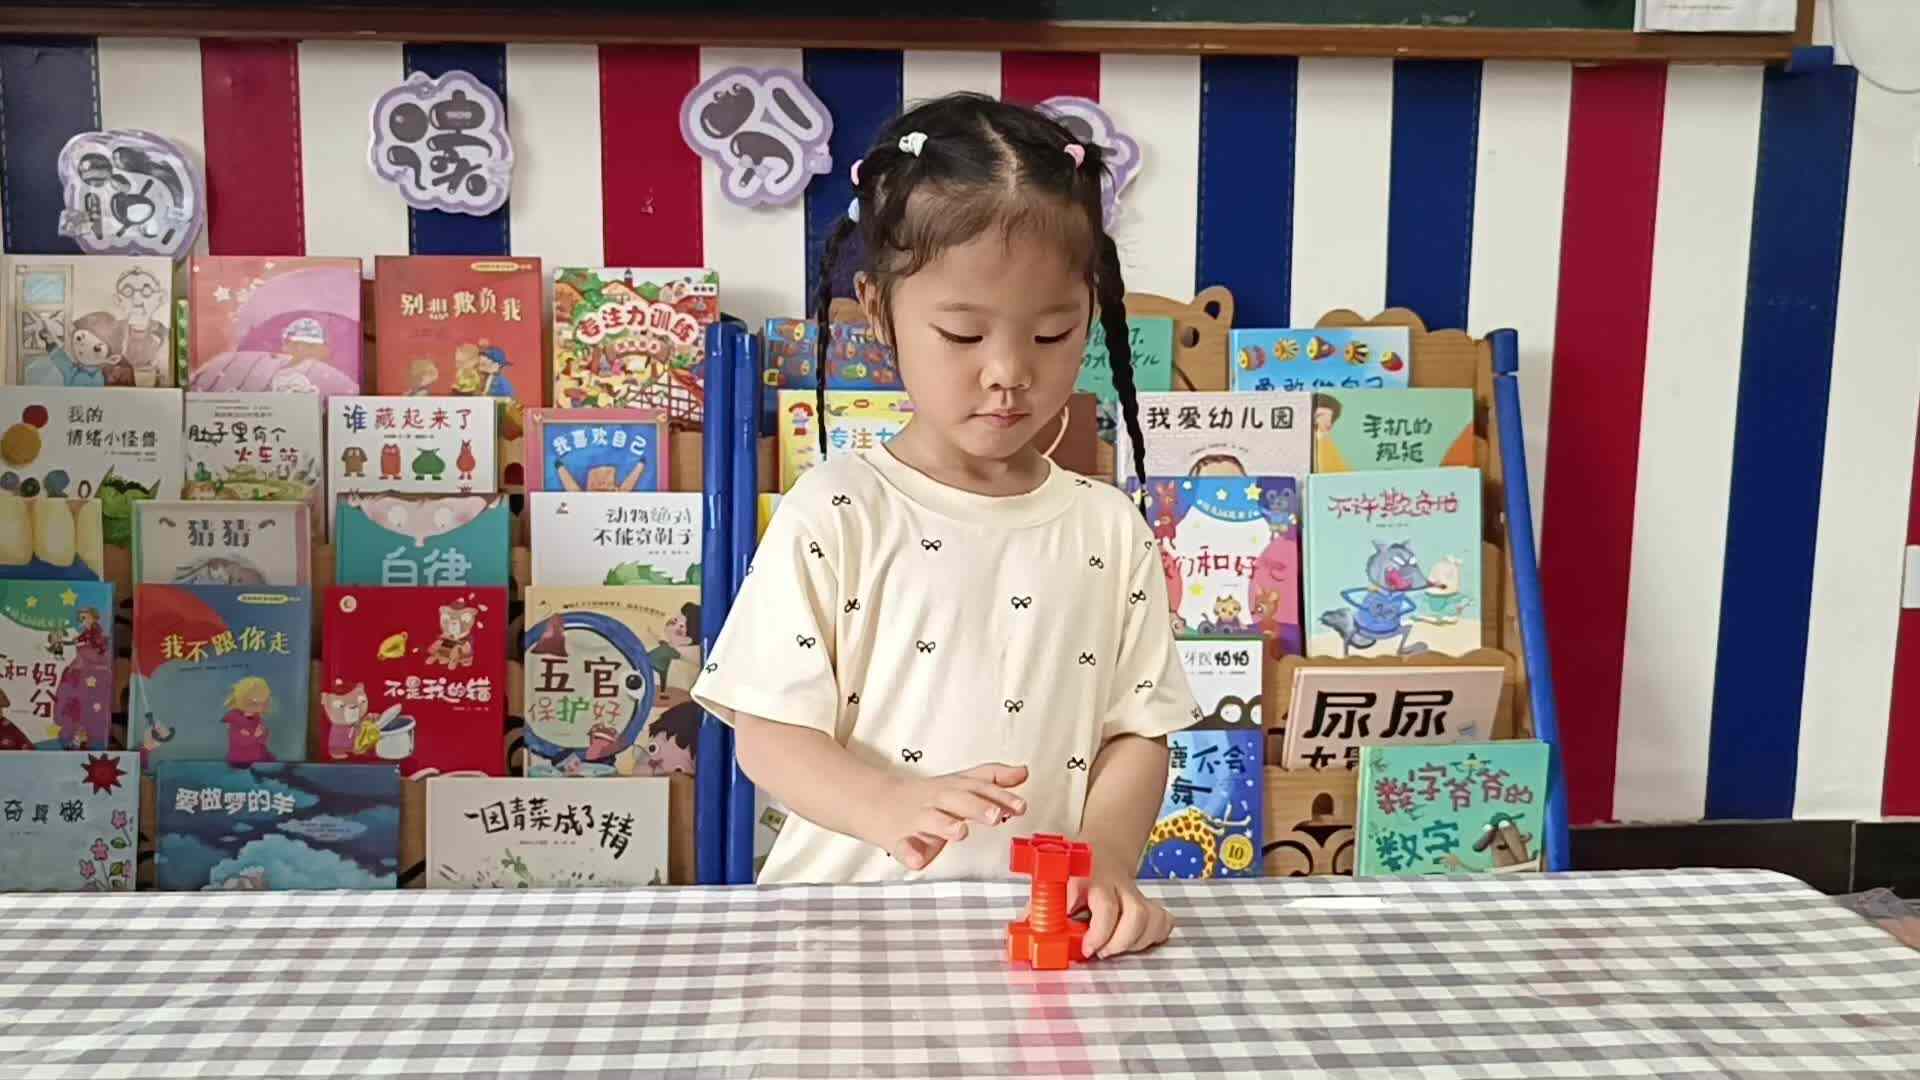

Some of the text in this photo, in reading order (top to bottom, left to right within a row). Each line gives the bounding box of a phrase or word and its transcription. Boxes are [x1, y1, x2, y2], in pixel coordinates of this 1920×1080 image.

[400, 287, 521, 321] 别想欺负我
[581, 305, 695, 342] 专注力训练
[67, 404, 103, 424] 我的
[343, 404, 472, 433] 谁藏起来了
[1147, 405, 1294, 430] 我爱幼儿园
[1363, 413, 1432, 438] 手机的
[66, 429, 158, 448] 情绪小怪兽
[189, 421, 287, 446] 肚子里有个
[552, 427, 648, 456] 我喜欢自己
[1376, 440, 1424, 463] 规矩
[188, 518, 250, 548] 猜猜
[381, 546, 472, 587] 自律
[160, 626, 291, 663] 我不跟你走
[1184, 650, 1249, 667] 牙医怕怕
[384, 676, 491, 703] 不是我的错
[535, 656, 622, 698] 五官
[528, 696, 622, 724] 保护好
[1303, 690, 1454, 738] 尿尿
[1228, 844, 1245, 861] 10
[1376, 819, 1460, 872] 数字
